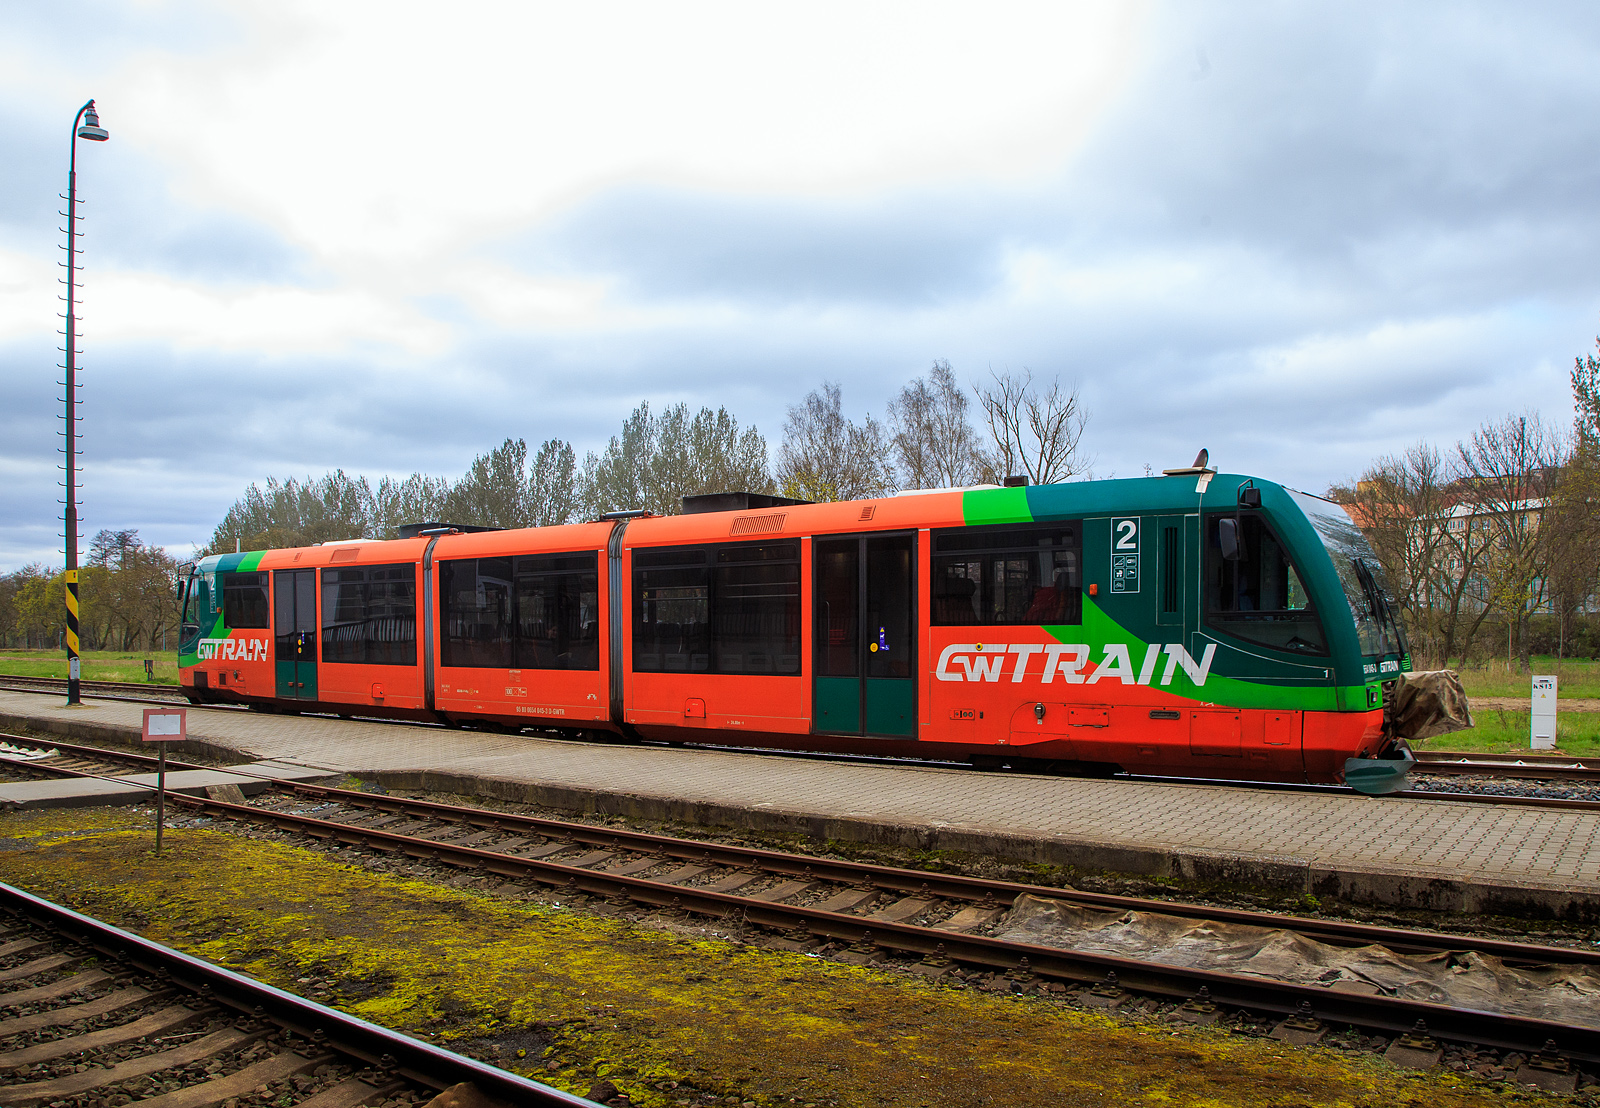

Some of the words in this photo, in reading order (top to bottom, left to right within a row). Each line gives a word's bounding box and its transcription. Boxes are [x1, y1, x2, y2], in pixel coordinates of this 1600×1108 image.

[1116, 520, 1137, 550] 2
[210, 576, 216, 591] 2
[936, 642, 1218, 687] GWTRAIN
[1323, 669, 1329, 679] 1
